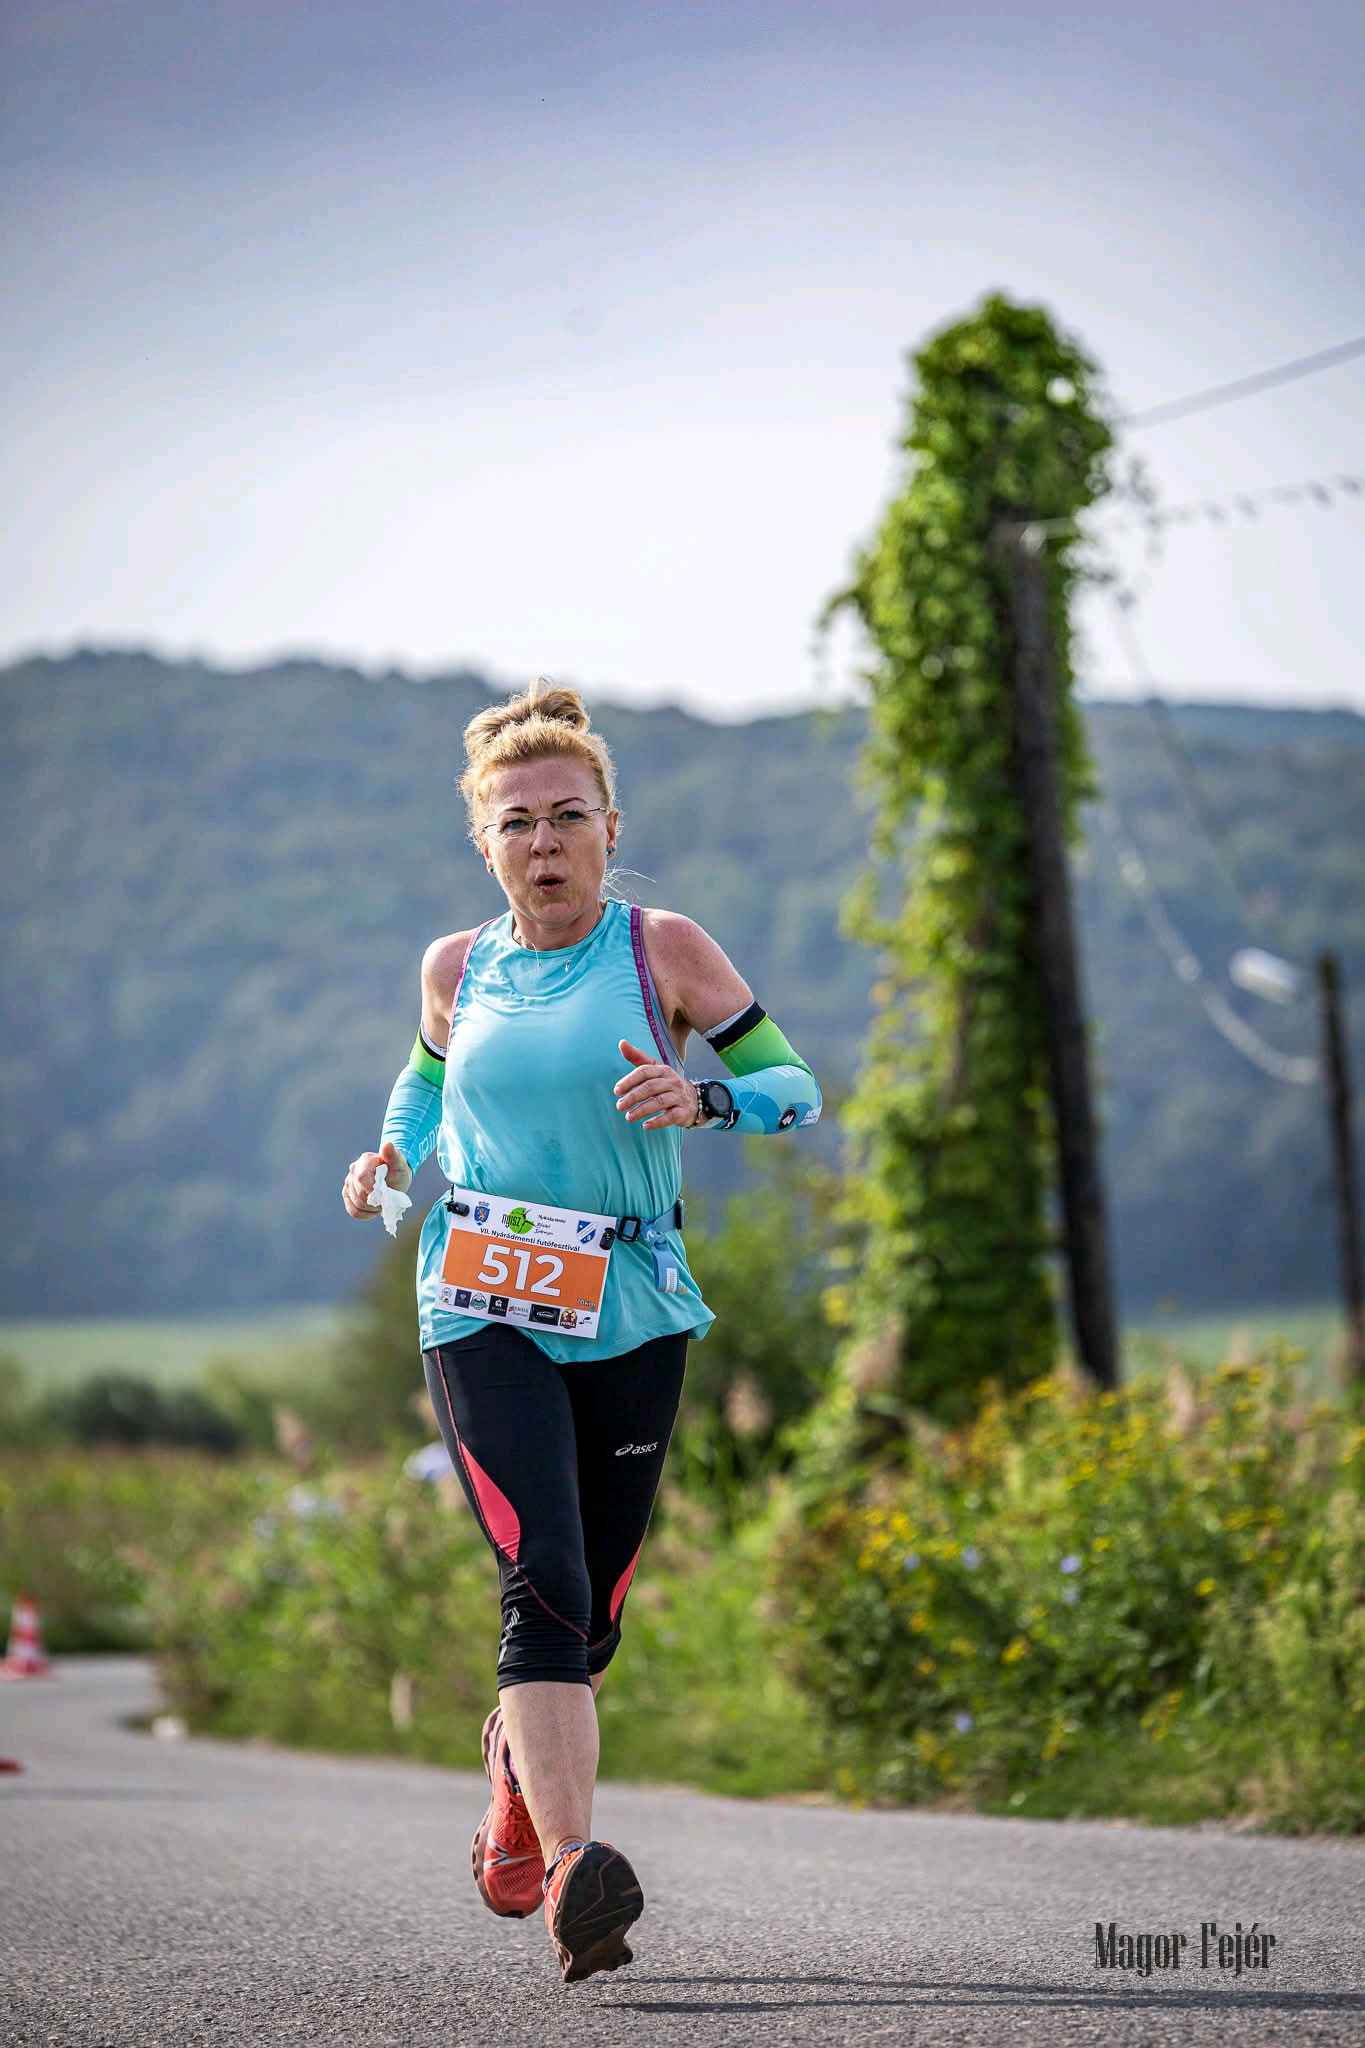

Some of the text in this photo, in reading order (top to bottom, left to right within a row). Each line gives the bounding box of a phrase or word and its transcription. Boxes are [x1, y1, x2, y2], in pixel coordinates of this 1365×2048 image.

[480, 1228, 580, 1252] VII. Nyárádmenti futófesztivál
[477, 1243, 565, 1297] 512
[631, 1441, 658, 1455] asics
